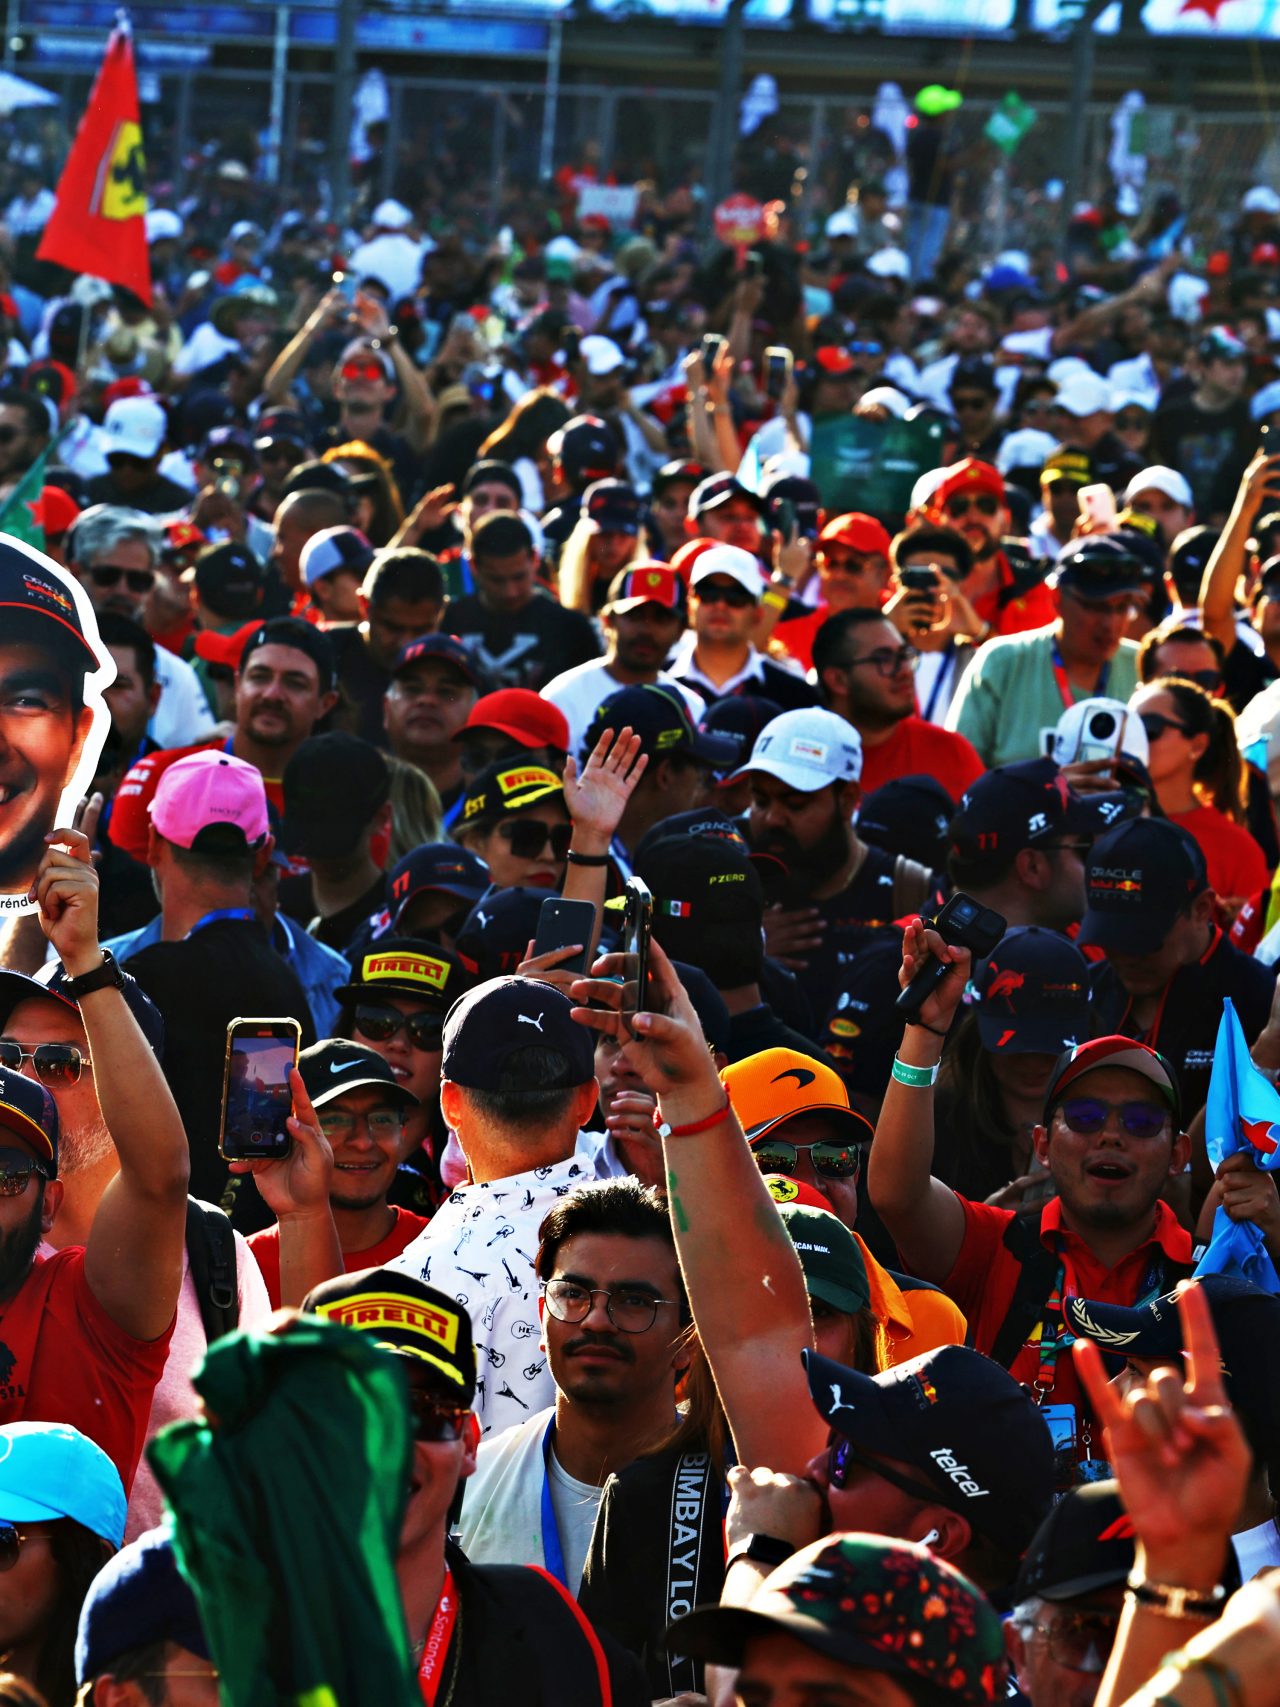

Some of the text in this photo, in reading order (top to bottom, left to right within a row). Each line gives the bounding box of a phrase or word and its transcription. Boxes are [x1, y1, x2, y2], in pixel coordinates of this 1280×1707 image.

[977, 832, 998, 849] 11
[392, 870, 411, 898] 11
[1091, 867, 1142, 880] ORACLE
[368, 957, 444, 981] PIRELLI
[930, 1448, 990, 1498] telcel
[420, 1613, 449, 1680] Santander
